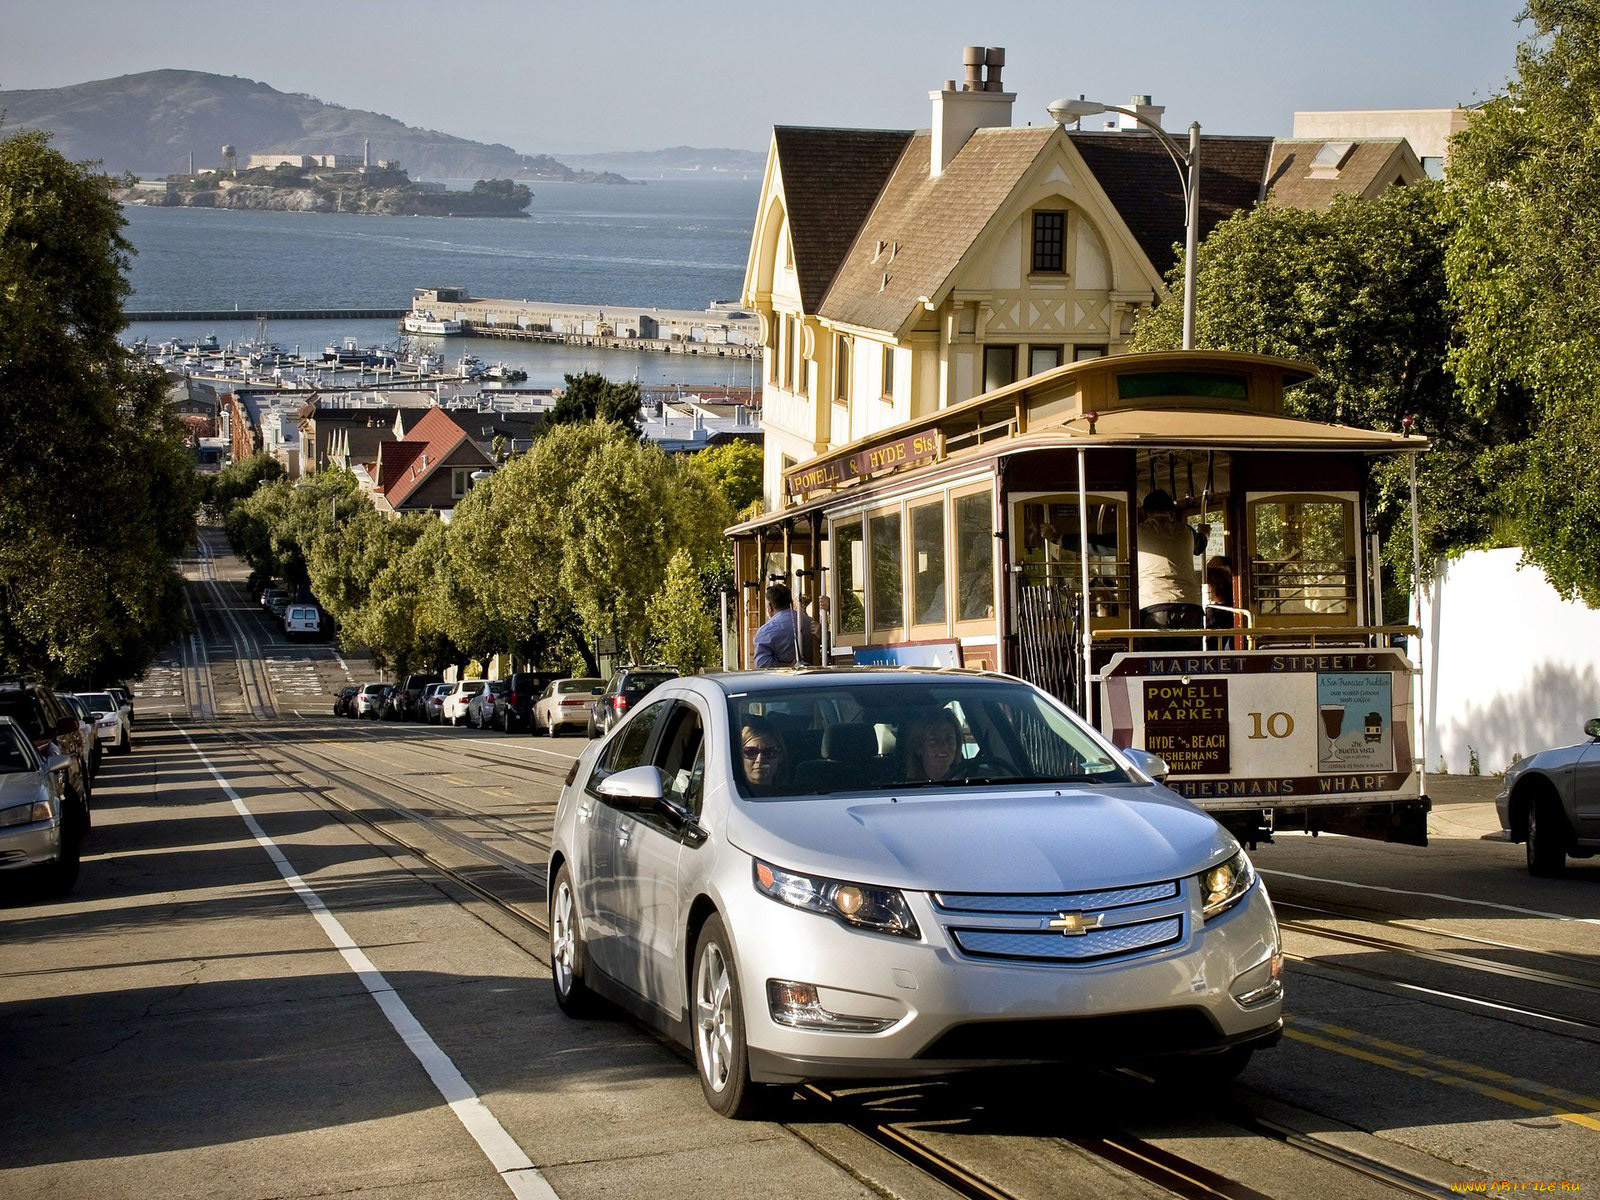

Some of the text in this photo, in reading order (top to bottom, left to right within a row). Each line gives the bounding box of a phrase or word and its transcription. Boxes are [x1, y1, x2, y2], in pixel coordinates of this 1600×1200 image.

[794, 436, 935, 491] POWELL & HYDE Sts.
[1150, 657, 1247, 672] MARKET
[1271, 655, 1357, 672] STREET
[1148, 686, 1223, 699] POWELL
[1168, 699, 1205, 708] AND
[1147, 708, 1225, 721] MARKET
[1247, 711, 1295, 739] 10
[1149, 735, 1225, 749] HYDE AND BEACH
[1170, 761, 1203, 771] WHARF
[1168, 775, 1387, 795] SHERMANS WHARF
